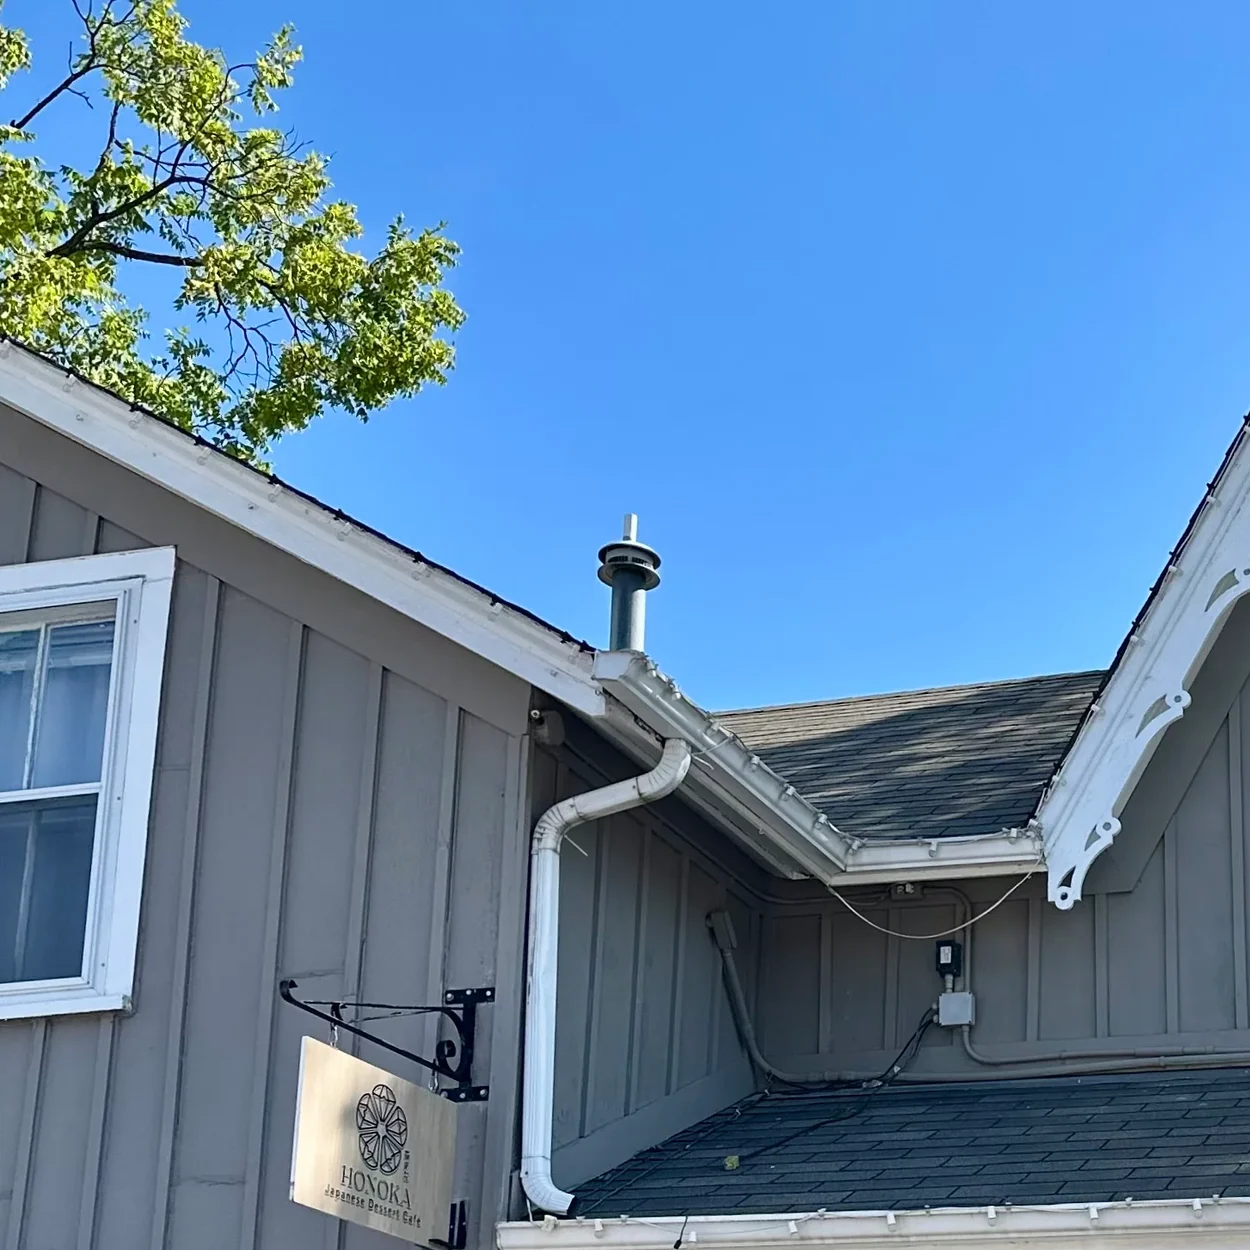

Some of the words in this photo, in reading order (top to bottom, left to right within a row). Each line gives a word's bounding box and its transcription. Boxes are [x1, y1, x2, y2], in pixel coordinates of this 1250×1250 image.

[325, 1184, 365, 1208] Japanese
[368, 1198, 401, 1221] Dessert
[340, 1165, 411, 1210] HONOKA
